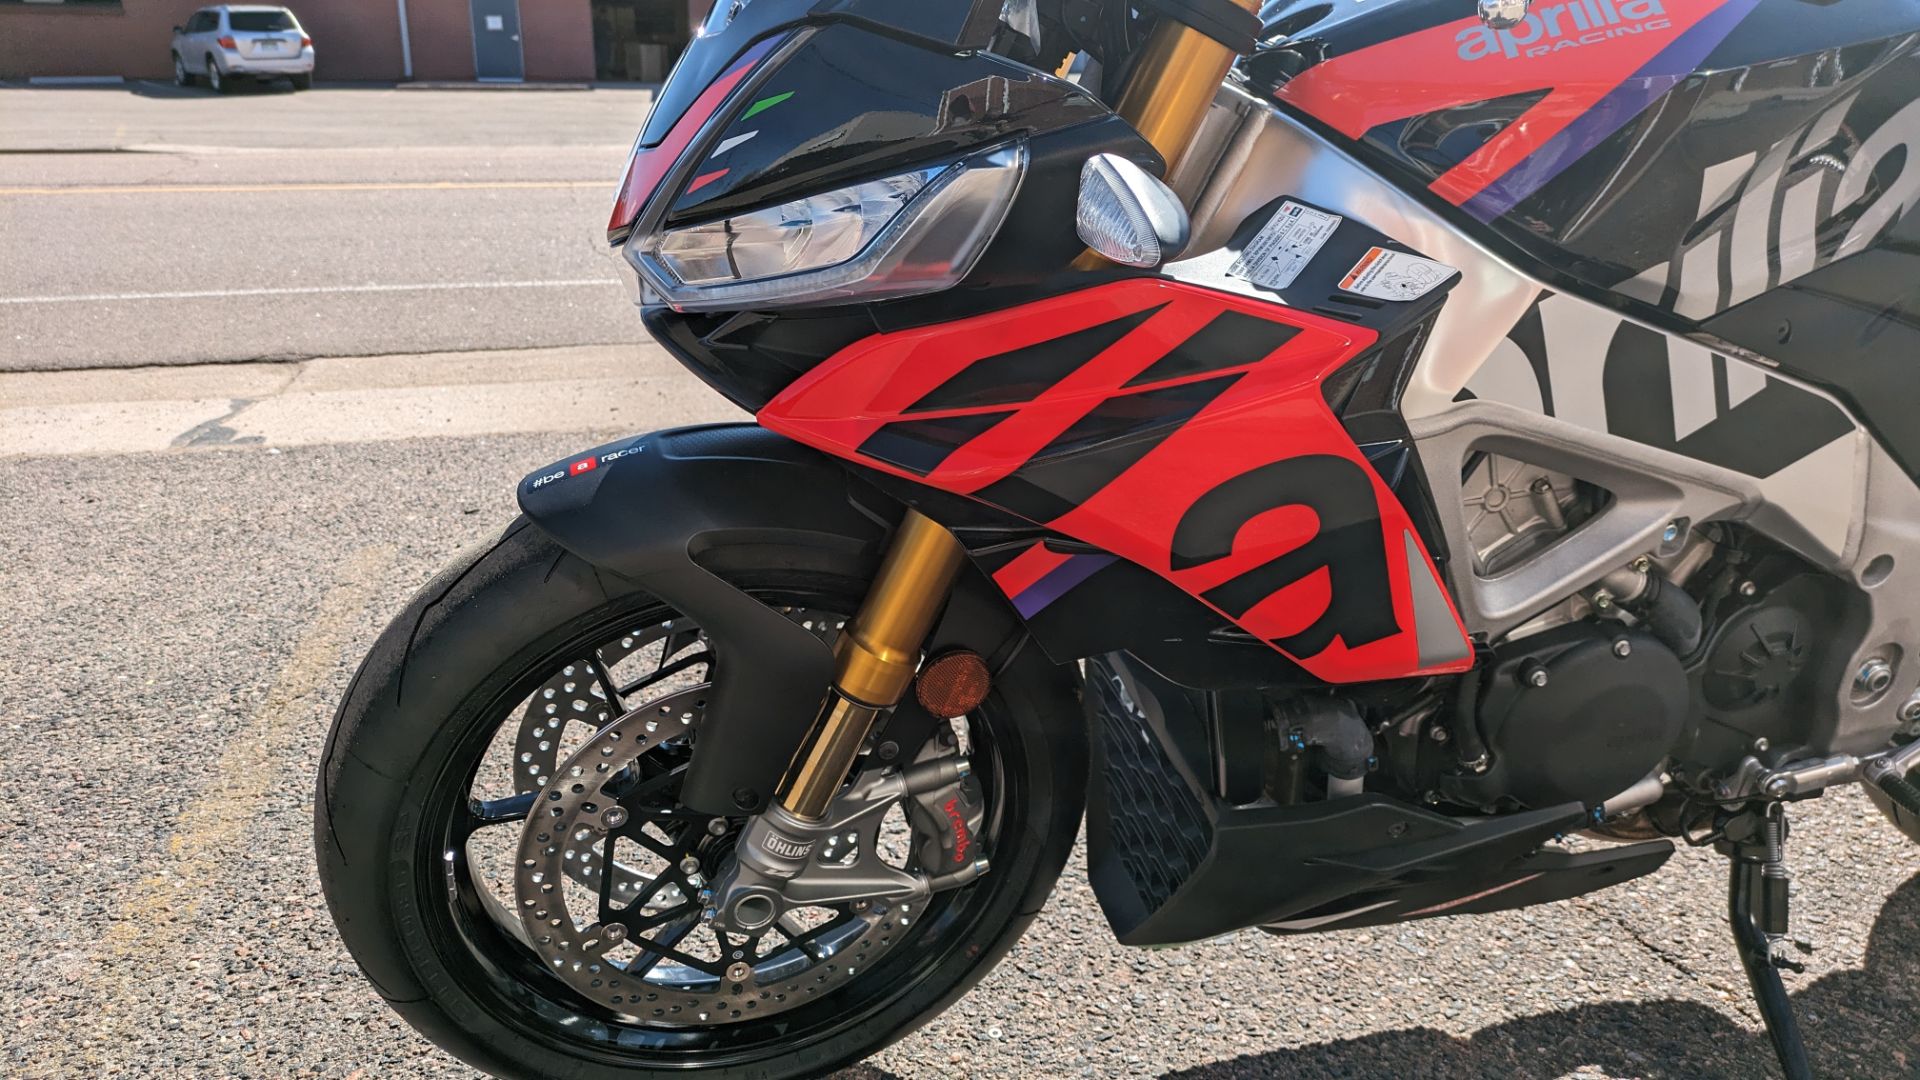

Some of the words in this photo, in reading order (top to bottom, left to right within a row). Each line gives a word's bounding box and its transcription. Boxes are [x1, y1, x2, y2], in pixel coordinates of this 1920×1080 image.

[1455, 0, 1666, 61] aprilia
[1526, 18, 1671, 58] RACING
[532, 470, 565, 488] #be
[601, 444, 645, 463] racer
[944, 798, 970, 862] brembo
